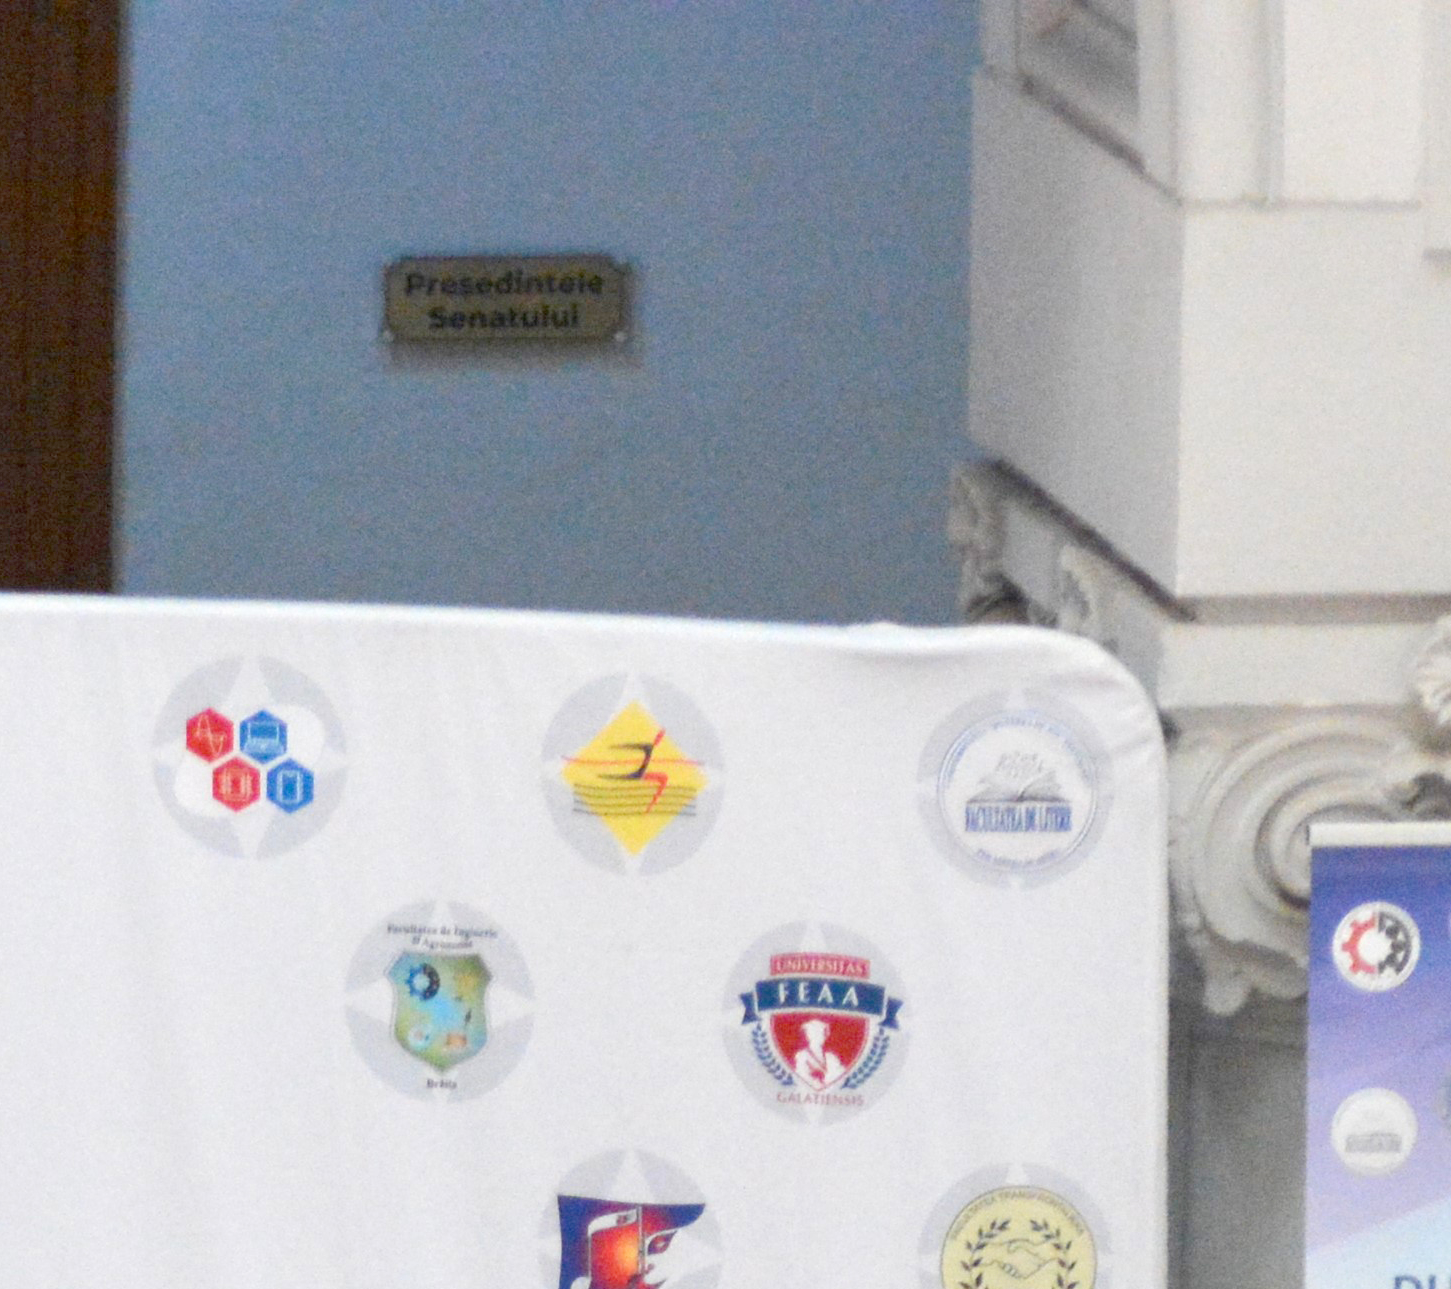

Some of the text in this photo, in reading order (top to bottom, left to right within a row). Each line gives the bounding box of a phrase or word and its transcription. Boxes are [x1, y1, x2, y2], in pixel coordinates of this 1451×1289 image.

[428, 302, 580, 329] Senatului
[774, 957, 866, 975] UNIVERSITAS
[778, 981, 860, 1007] FEAA
[776, 1091, 864, 1106] GALATIENSIS
